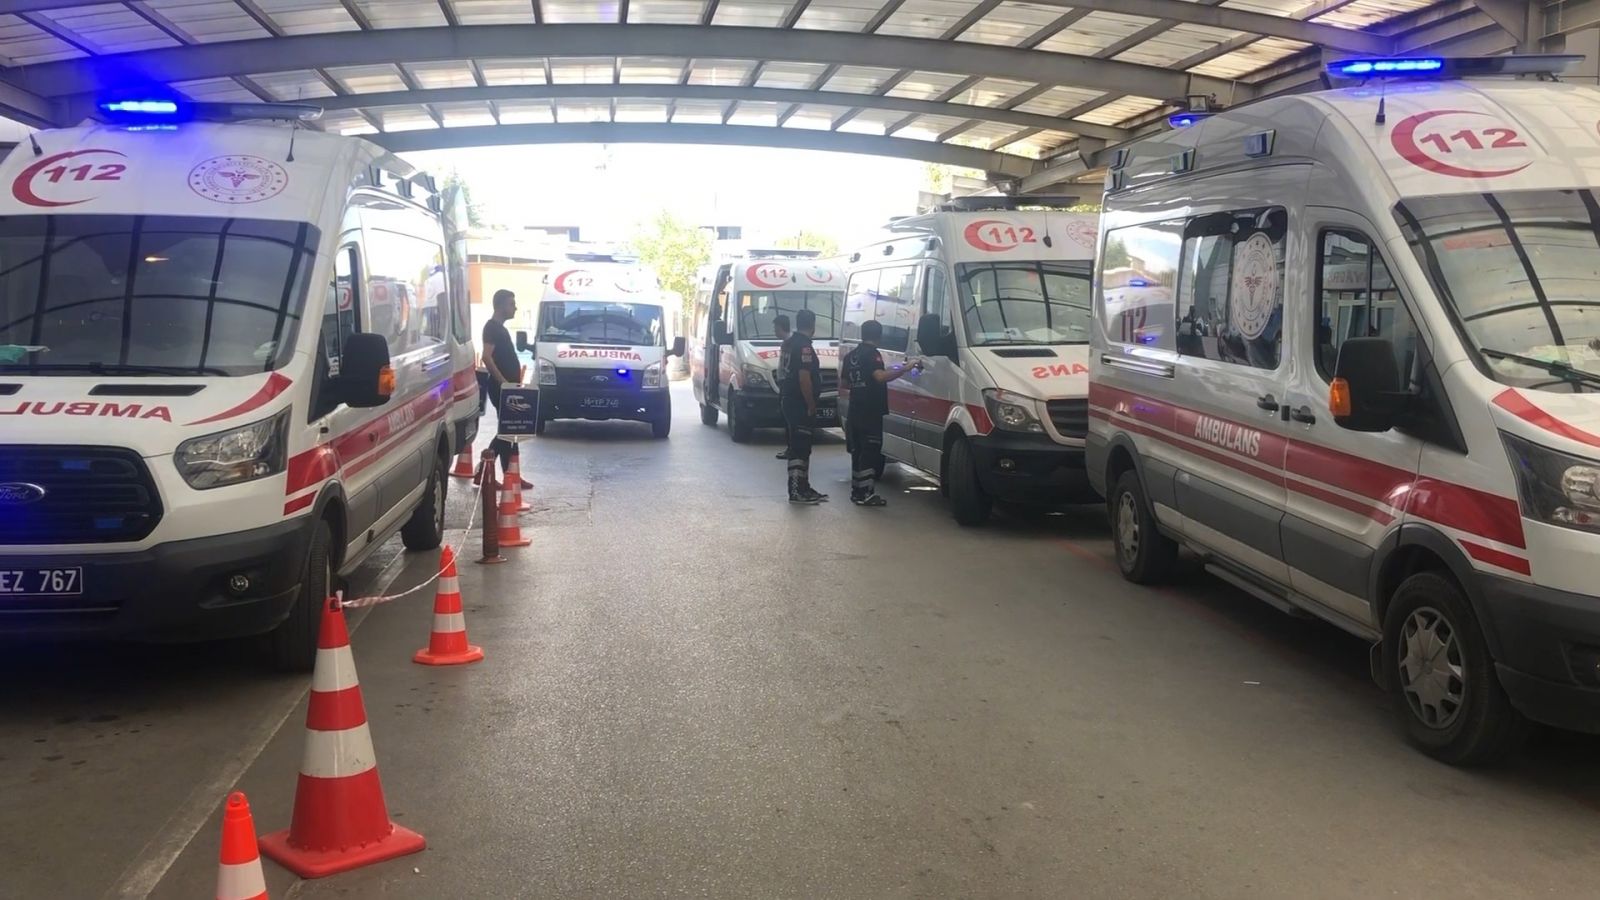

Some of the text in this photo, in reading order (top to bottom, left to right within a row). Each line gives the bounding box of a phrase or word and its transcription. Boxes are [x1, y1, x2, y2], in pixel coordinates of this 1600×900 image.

[1420, 128, 1527, 153] 112
[44, 164, 126, 183] 112
[988, 227, 1037, 243] 112
[760, 269, 788, 278] 112
[1194, 415, 1261, 457] AMBULANS
[39, 571, 77, 592] 767
